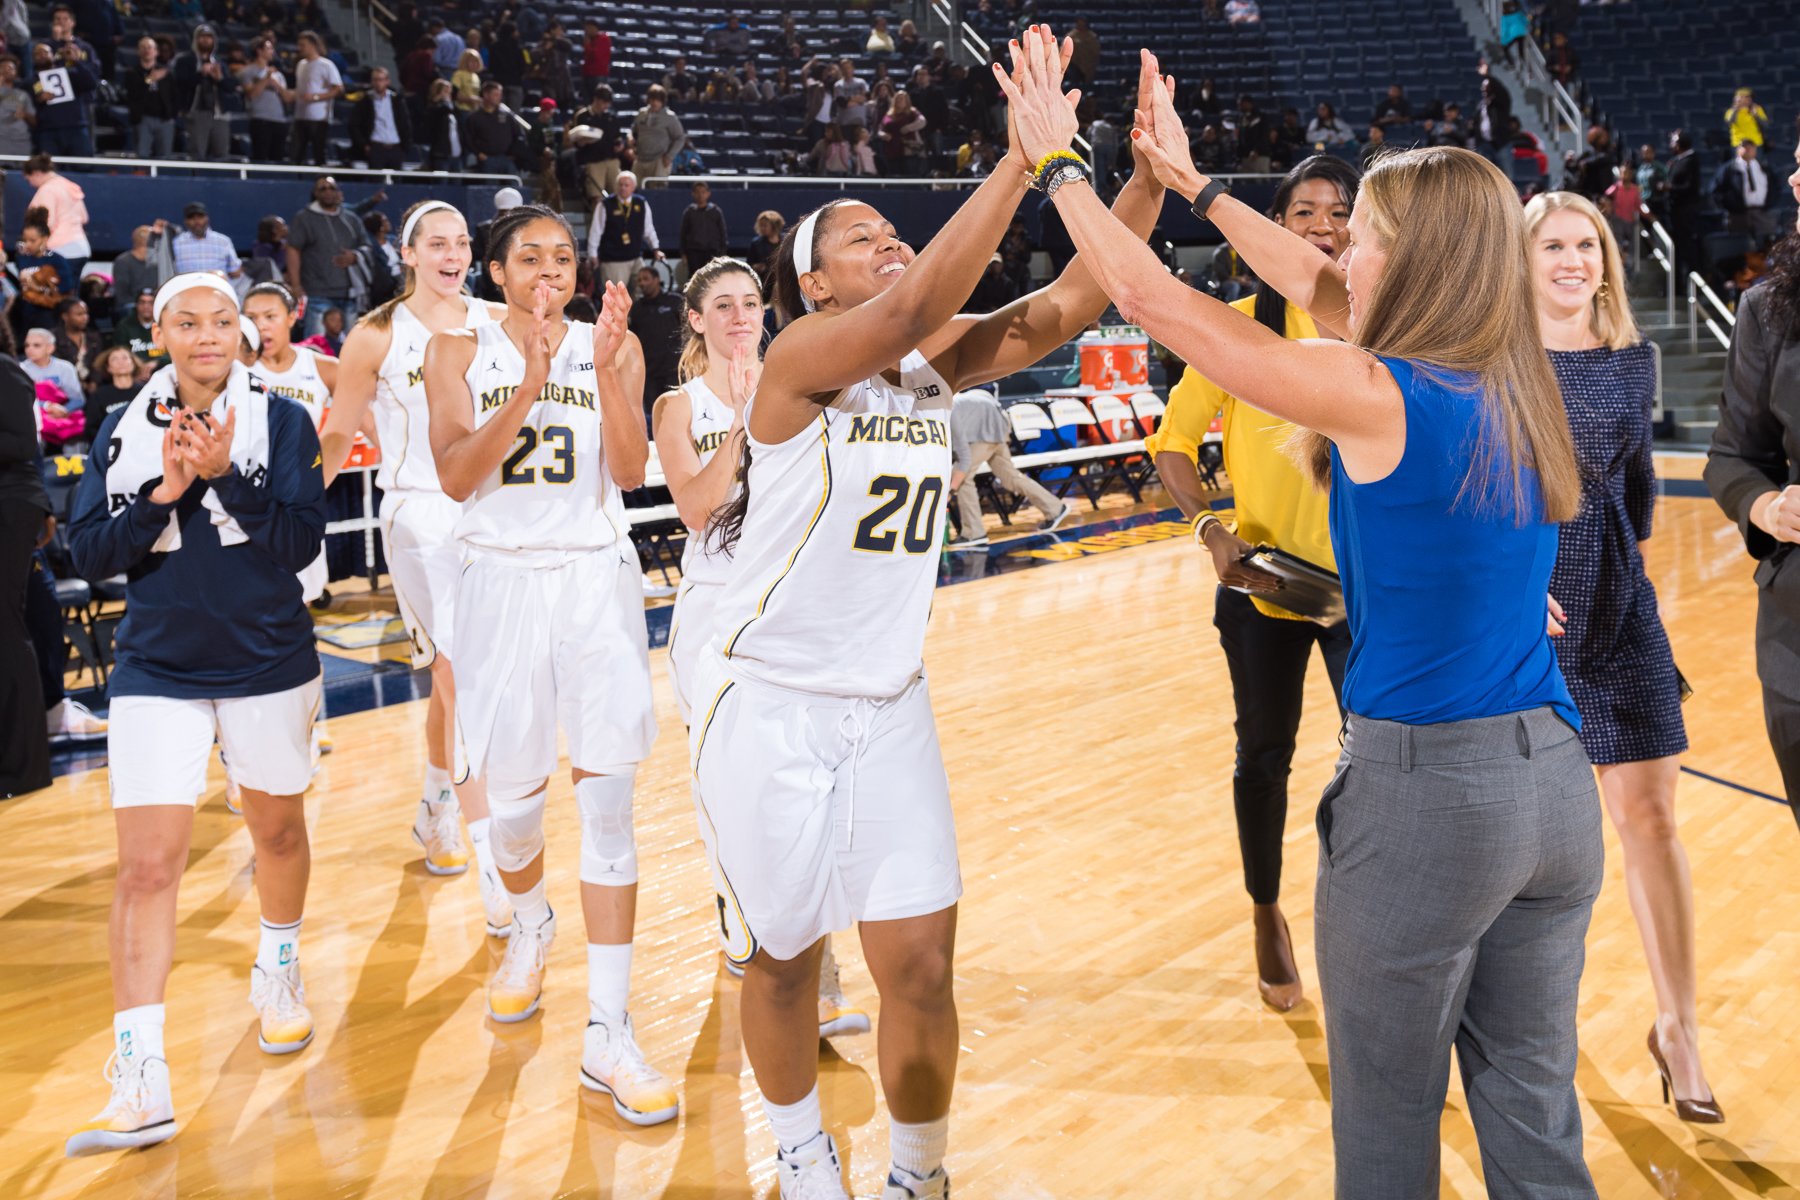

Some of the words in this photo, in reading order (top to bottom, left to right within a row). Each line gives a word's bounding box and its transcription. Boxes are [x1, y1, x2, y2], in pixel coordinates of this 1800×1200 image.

[47, 73, 66, 98] 3
[54, 454, 86, 477] M
[502, 424, 575, 486] 23
[852, 474, 943, 555] 20
